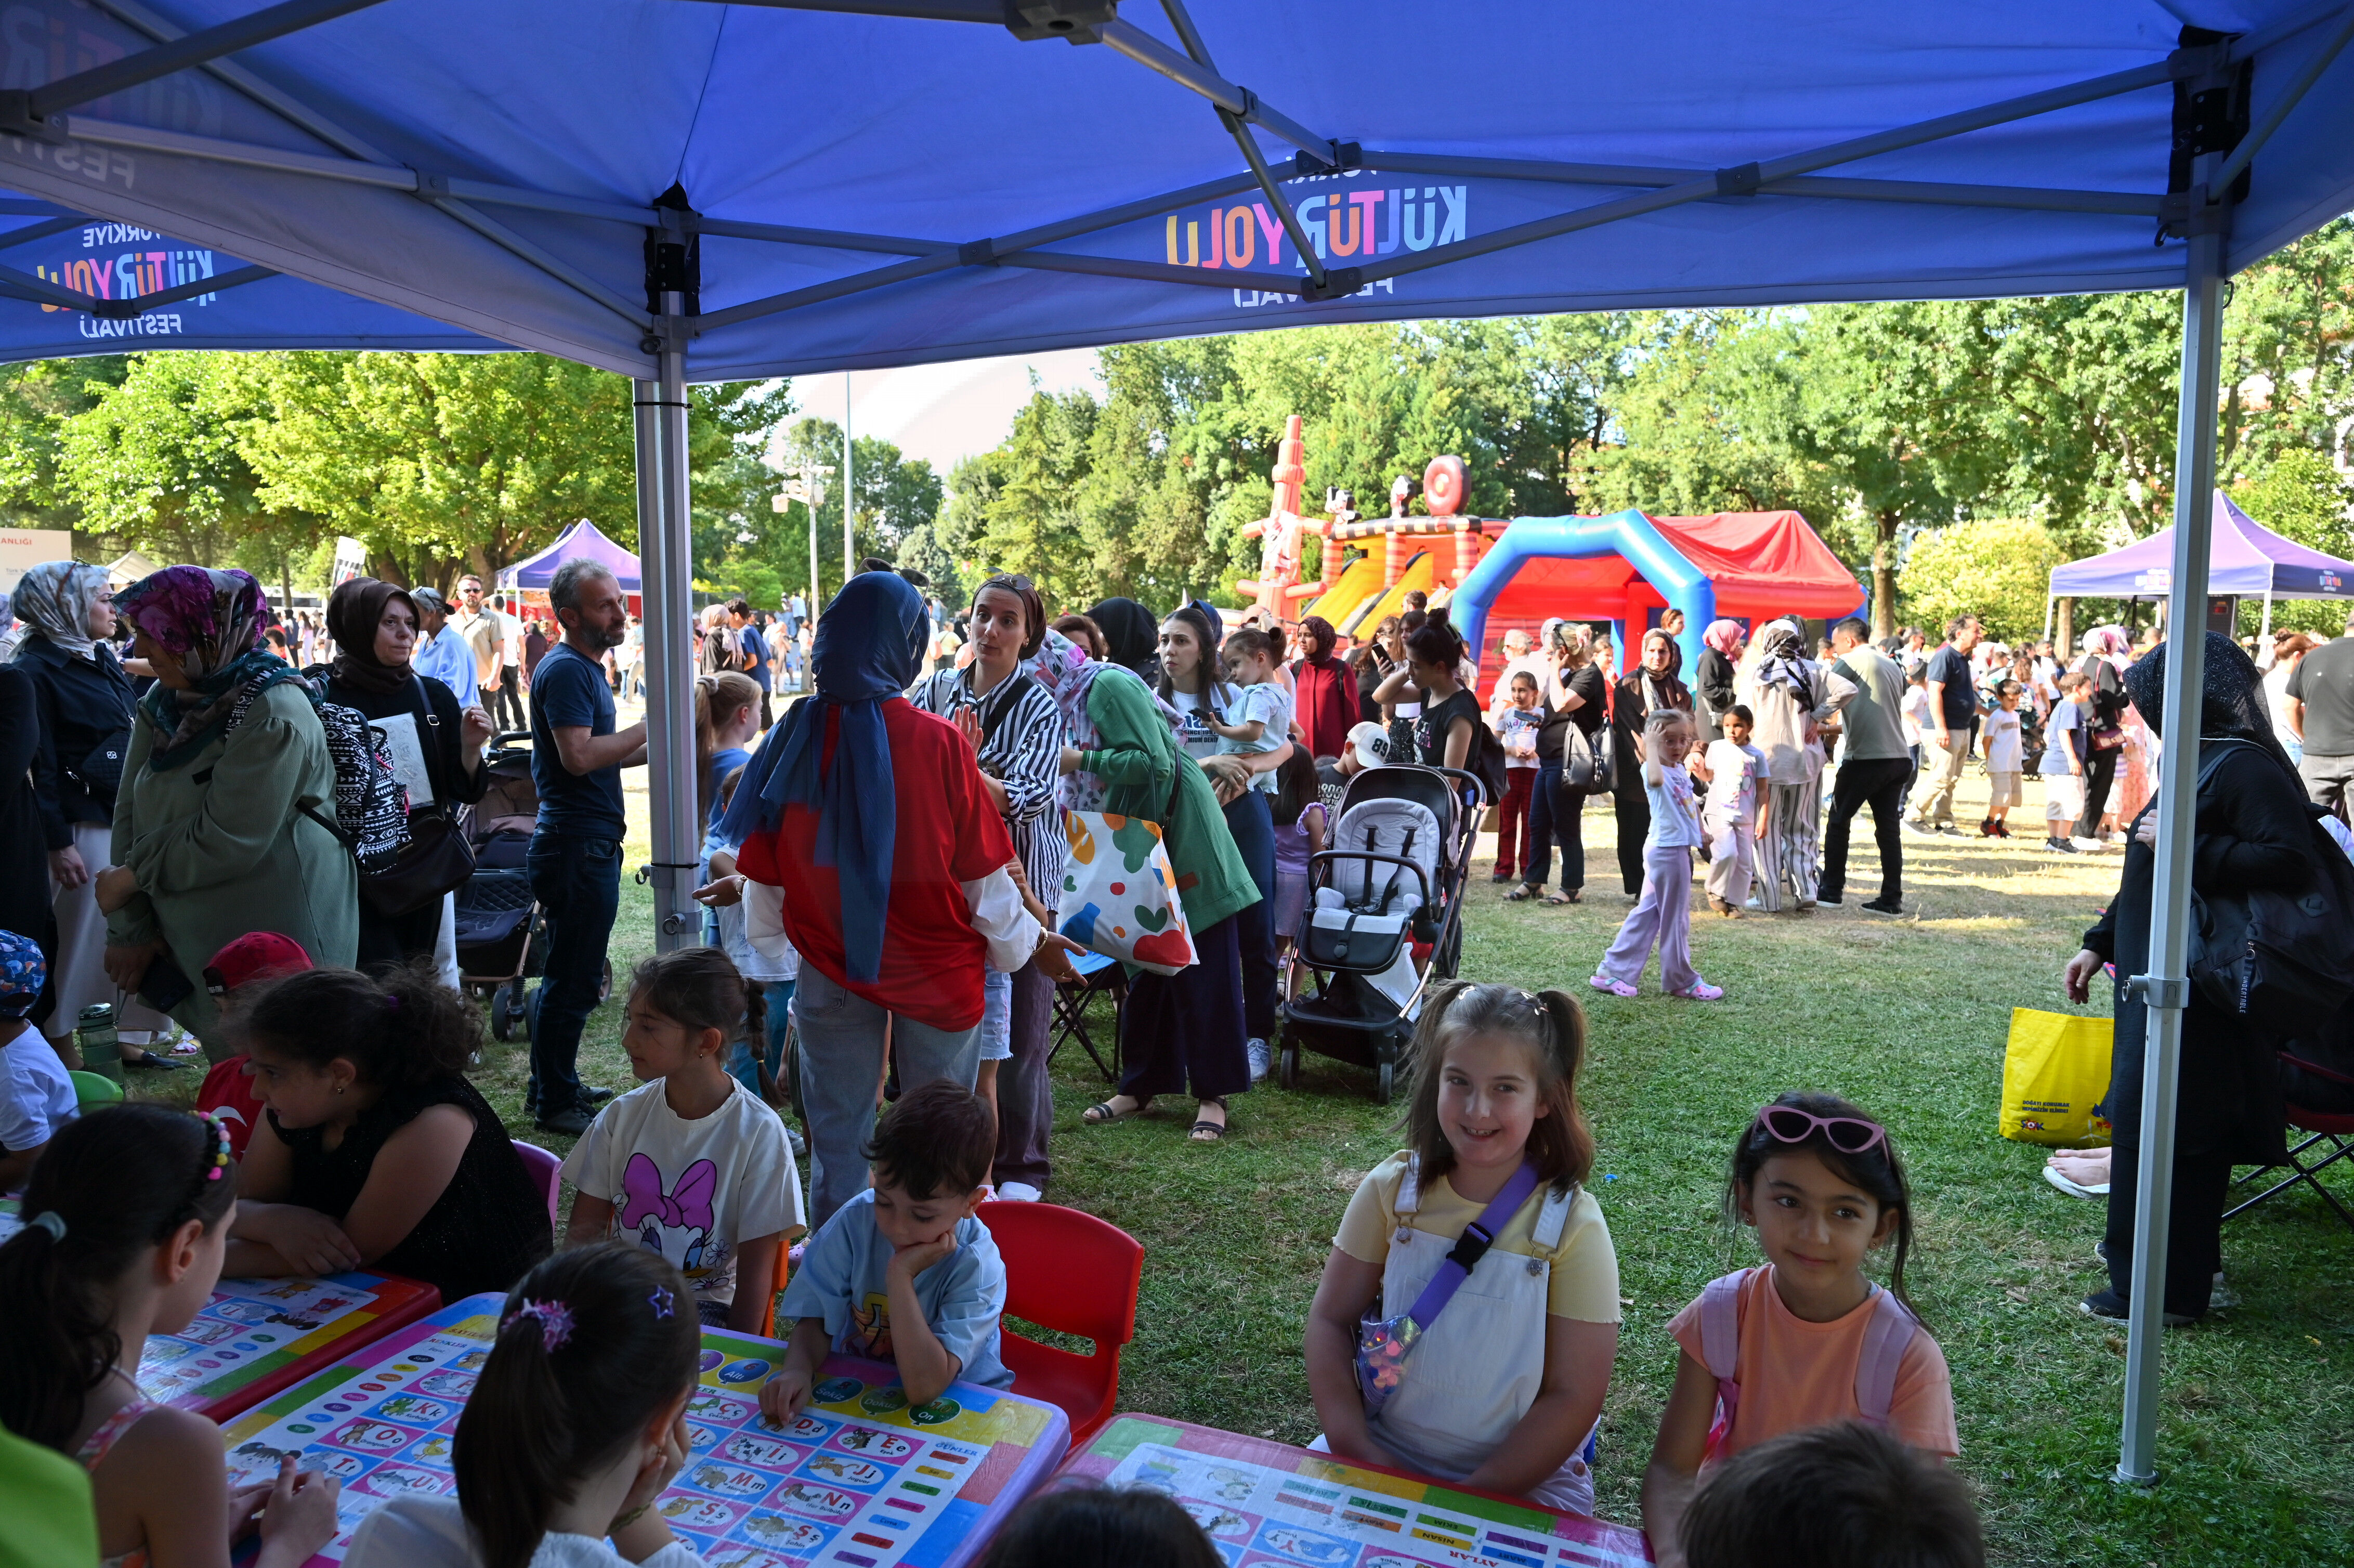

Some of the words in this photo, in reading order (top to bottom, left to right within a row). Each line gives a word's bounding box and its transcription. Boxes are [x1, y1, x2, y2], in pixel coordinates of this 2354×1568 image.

[1506, 720, 1534, 733] Happ
[1371, 738, 1389, 757] 89
[2239, 976, 2249, 1014] UNBEATABLE
[2020, 1119, 2045, 1132] ŞOK
[429, 1338, 468, 1348] RENKLER
[815, 1387, 845, 1401] Sekiz
[413, 1402, 437, 1414] K
[864, 1397, 898, 1408] Dokuz
[933, 1401, 953, 1413] 10
[919, 1411, 934, 1420] On
[796, 1418, 814, 1429] D
[812, 1425, 825, 1433] d
[375, 1429, 397, 1441] O
[881, 1437, 898, 1449] E
[333, 1457, 355, 1470] T
[853, 1464, 871, 1475] J
[411, 1475, 434, 1488] U
[729, 1472, 755, 1485] M
[750, 1482, 766, 1491] m
[847, 1475, 871, 1485] Jaguar
[820, 1492, 843, 1507] N
[840, 1501, 851, 1510] n
[699, 1502, 721, 1516] S
[1434, 1519, 1459, 1531] EKİM
[792, 1525, 813, 1540] Ş
[1422, 1532, 1455, 1546] NİSAN
[1278, 1540, 1294, 1553] Y
[1449, 1550, 1500, 1567] AYLAR
